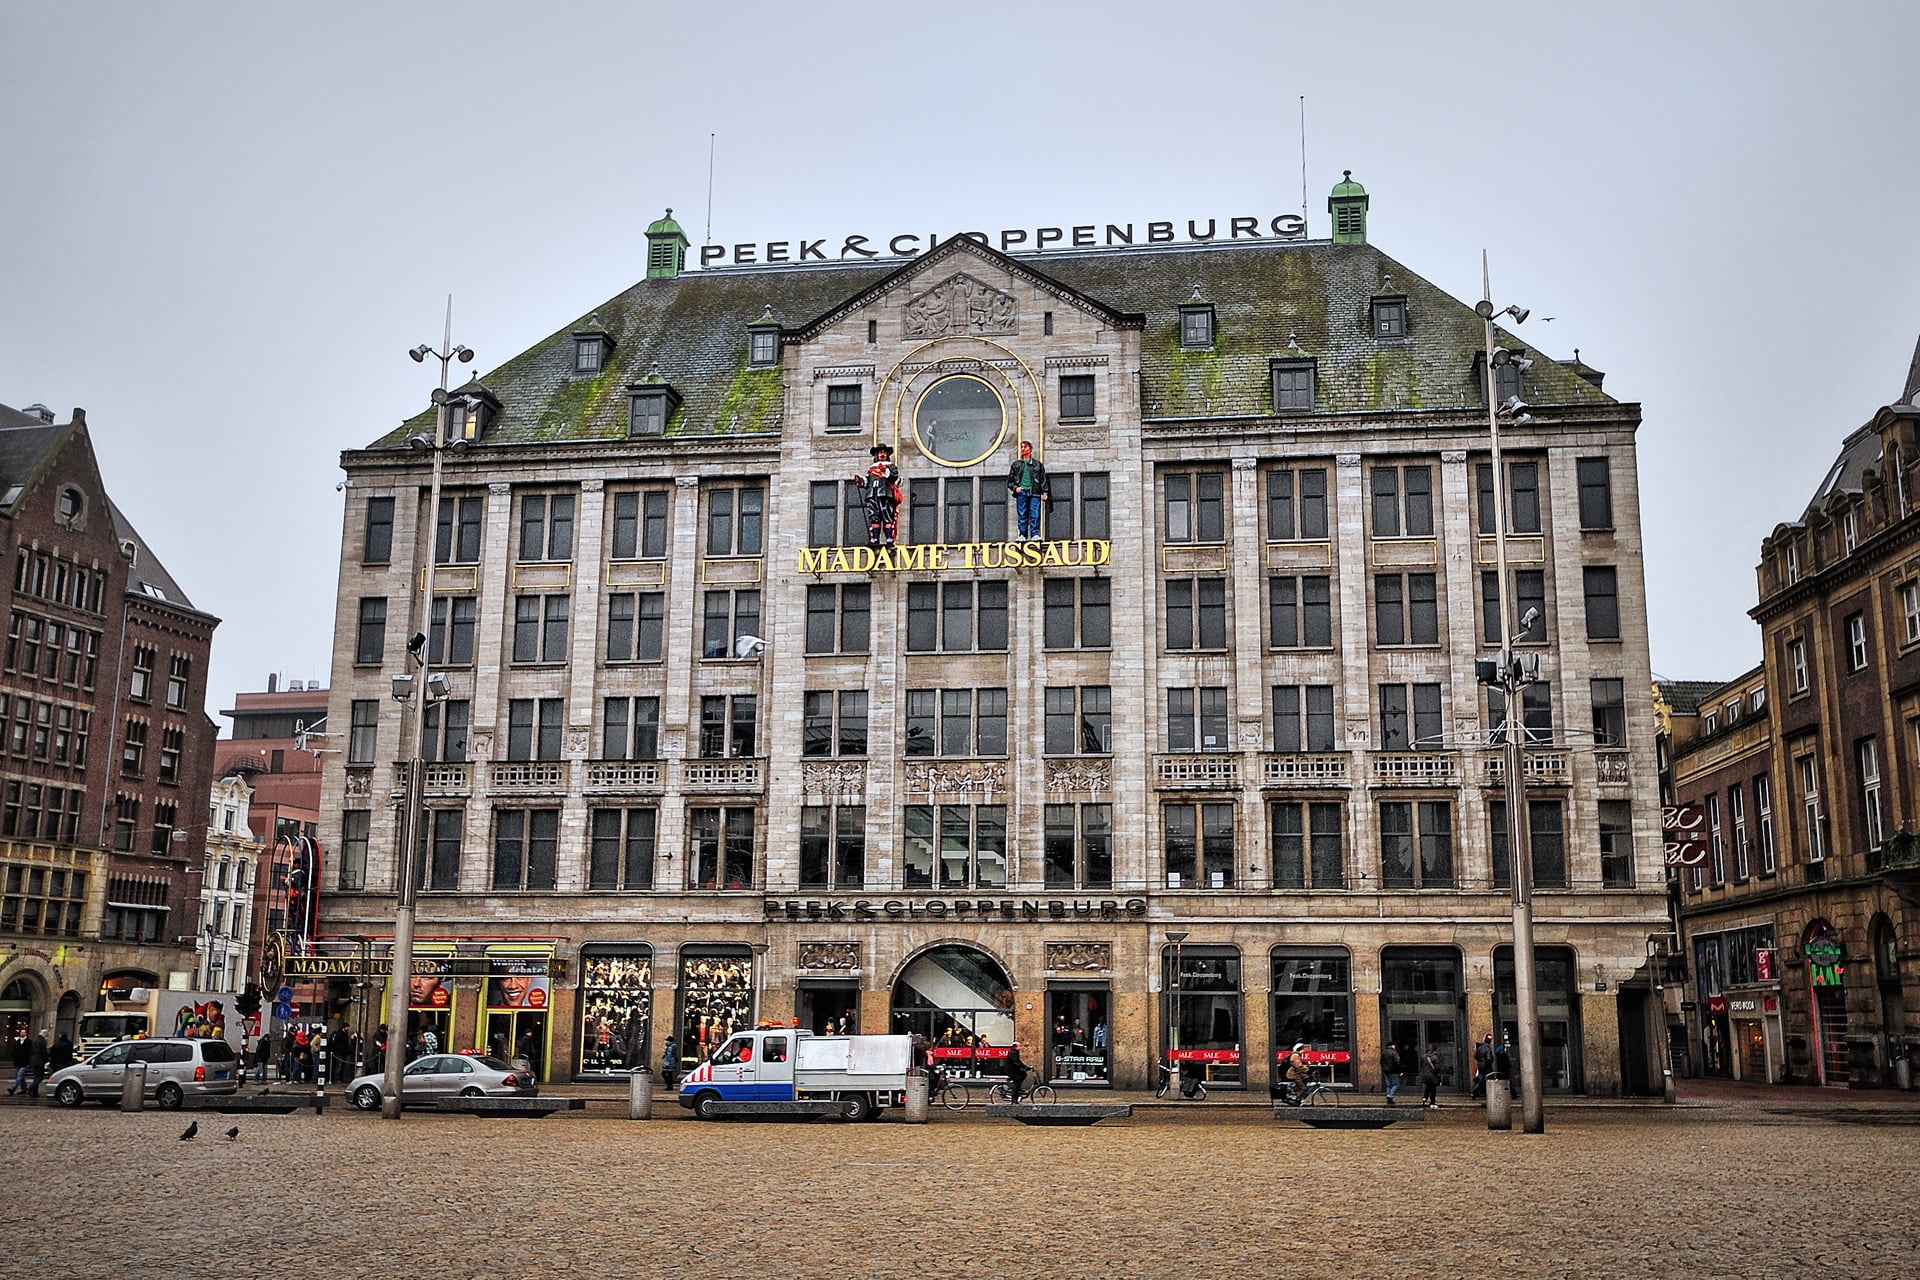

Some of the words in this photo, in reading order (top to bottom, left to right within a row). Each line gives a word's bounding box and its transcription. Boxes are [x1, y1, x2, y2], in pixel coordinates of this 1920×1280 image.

[799, 544, 948, 573] MADAME
[957, 539, 1110, 569] TUSSAUD
[293, 960, 361, 974] MADAME
